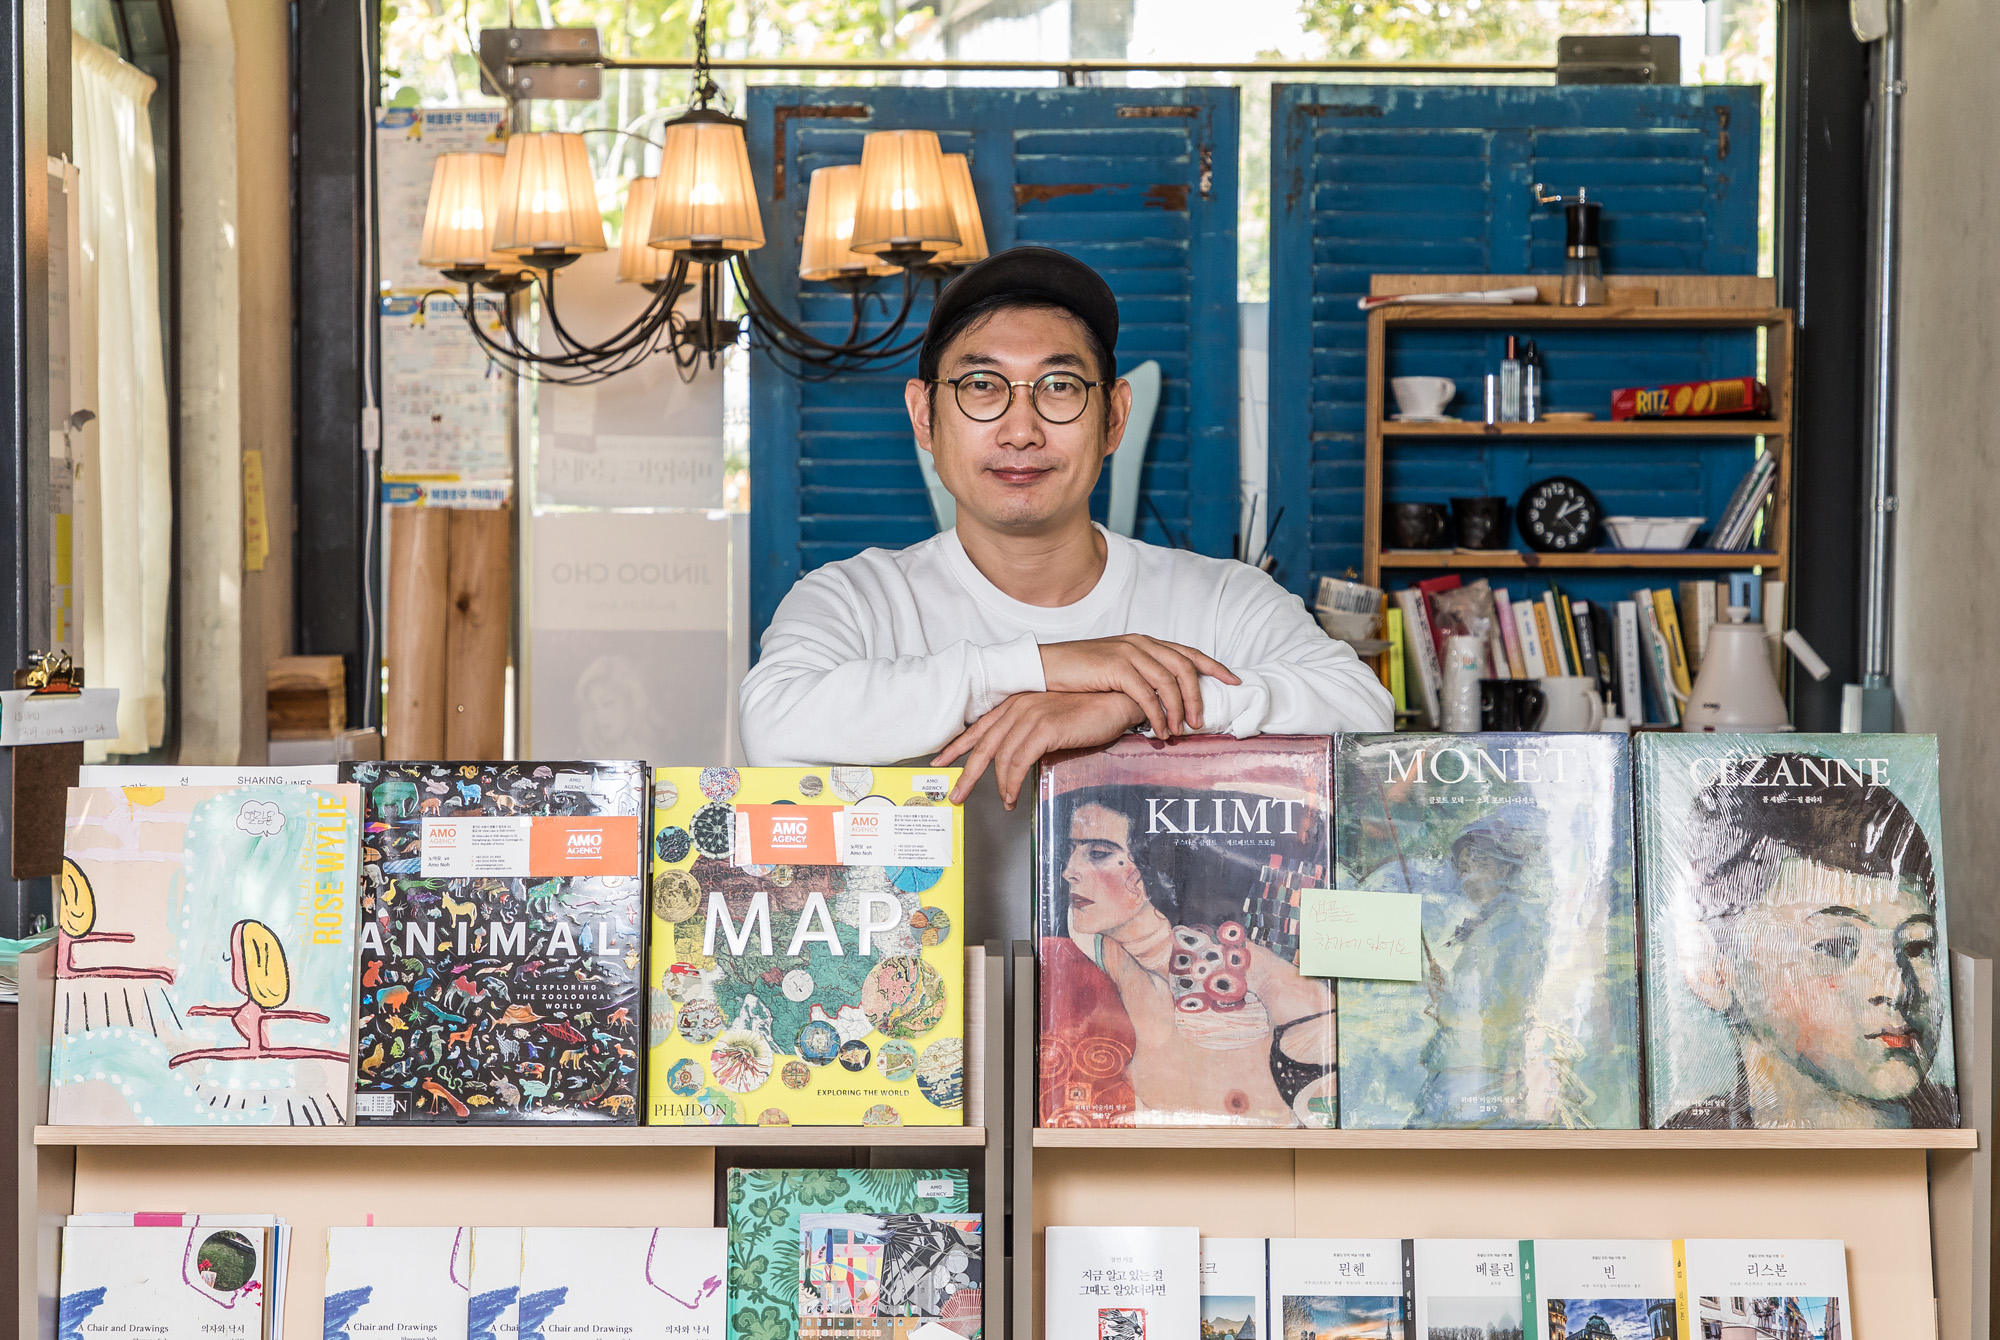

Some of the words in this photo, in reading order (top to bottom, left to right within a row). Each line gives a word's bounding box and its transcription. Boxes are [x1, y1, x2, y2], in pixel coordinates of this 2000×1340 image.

[1636, 389, 1670, 414] RITZ
[1541, 487, 1552, 498] 11
[1552, 482, 1565, 495] 12
[1568, 487, 1574, 499] 1
[1532, 497, 1547, 509] 10
[1575, 496, 1585, 508] 2
[1529, 509, 1540, 522] 9
[1580, 509, 1590, 522] 3
[1533, 521, 1544, 535] 8
[1577, 523, 1586, 535] 4
[1545, 532, 1554, 544] 7
[1555, 535, 1566, 548] 6
[1568, 532, 1578, 544] 5
[1384, 748, 1576, 784] MONET
[1690, 750, 1891, 787] CÉZANNE
[180, 776, 189, 786] 선
[237, 776, 283, 784] SHAKING
[244, 809, 276, 826] 열람용
[851, 817, 878, 826] AMO
[1144, 798, 1305, 834] KLIMT
[315, 796, 347, 873] WYLIE
[429, 828, 456, 838] AMO
[772, 822, 807, 835] AMO
[567, 834, 602, 846] AMO
[566, 847, 602, 855] AGENCY
[312, 881, 343, 944] ROSE
[1309, 899, 1357, 922] 샘플은
[703, 892, 902, 956] MAP
[361, 921, 620, 956] ANIMAL
[1312, 930, 1362, 950] 창가에
[1366, 933, 1412, 956] 있어요
[817, 1089, 861, 1097] EXPLORING
[863, 1089, 879, 1097] THE
[880, 1089, 910, 1097] WORLD
[654, 1103, 727, 1116] PHAIDON
[1338, 1261, 1366, 1277] 뮌헨
[1476, 1262, 1514, 1277] 베를린
[1604, 1264, 1616, 1279] 빈
[1748, 1262, 1788, 1278] 리스본
[1082, 1270, 1103, 1281] 지금
[1106, 1270, 1126, 1281] 알고
[1129, 1270, 1150, 1281] 있는
[1153, 1270, 1164, 1281] 걸
[1079, 1284, 1110, 1296] 그때도
[1113, 1284, 1166, 1296] 알았더라면
[78, 1324, 84, 1332] A
[87, 1324, 108, 1332] Chair
[111, 1324, 126, 1332] and
[129, 1324, 169, 1334] Drawings
[201, 1324, 225, 1333] 의자와
[228, 1324, 245, 1333] 낙서
[353, 1323, 375, 1331] Chair
[378, 1323, 394, 1331] and
[397, 1323, 438, 1333] Drawings
[490, 1324, 497, 1332] A
[500, 1324, 519, 1332] Chai
[549, 1325, 571, 1333] Chair
[573, 1325, 589, 1333] and
[592, 1325, 633, 1334] Drawings
[665, 1325, 690, 1334] 의자와
[693, 1325, 710, 1334] 낙서
